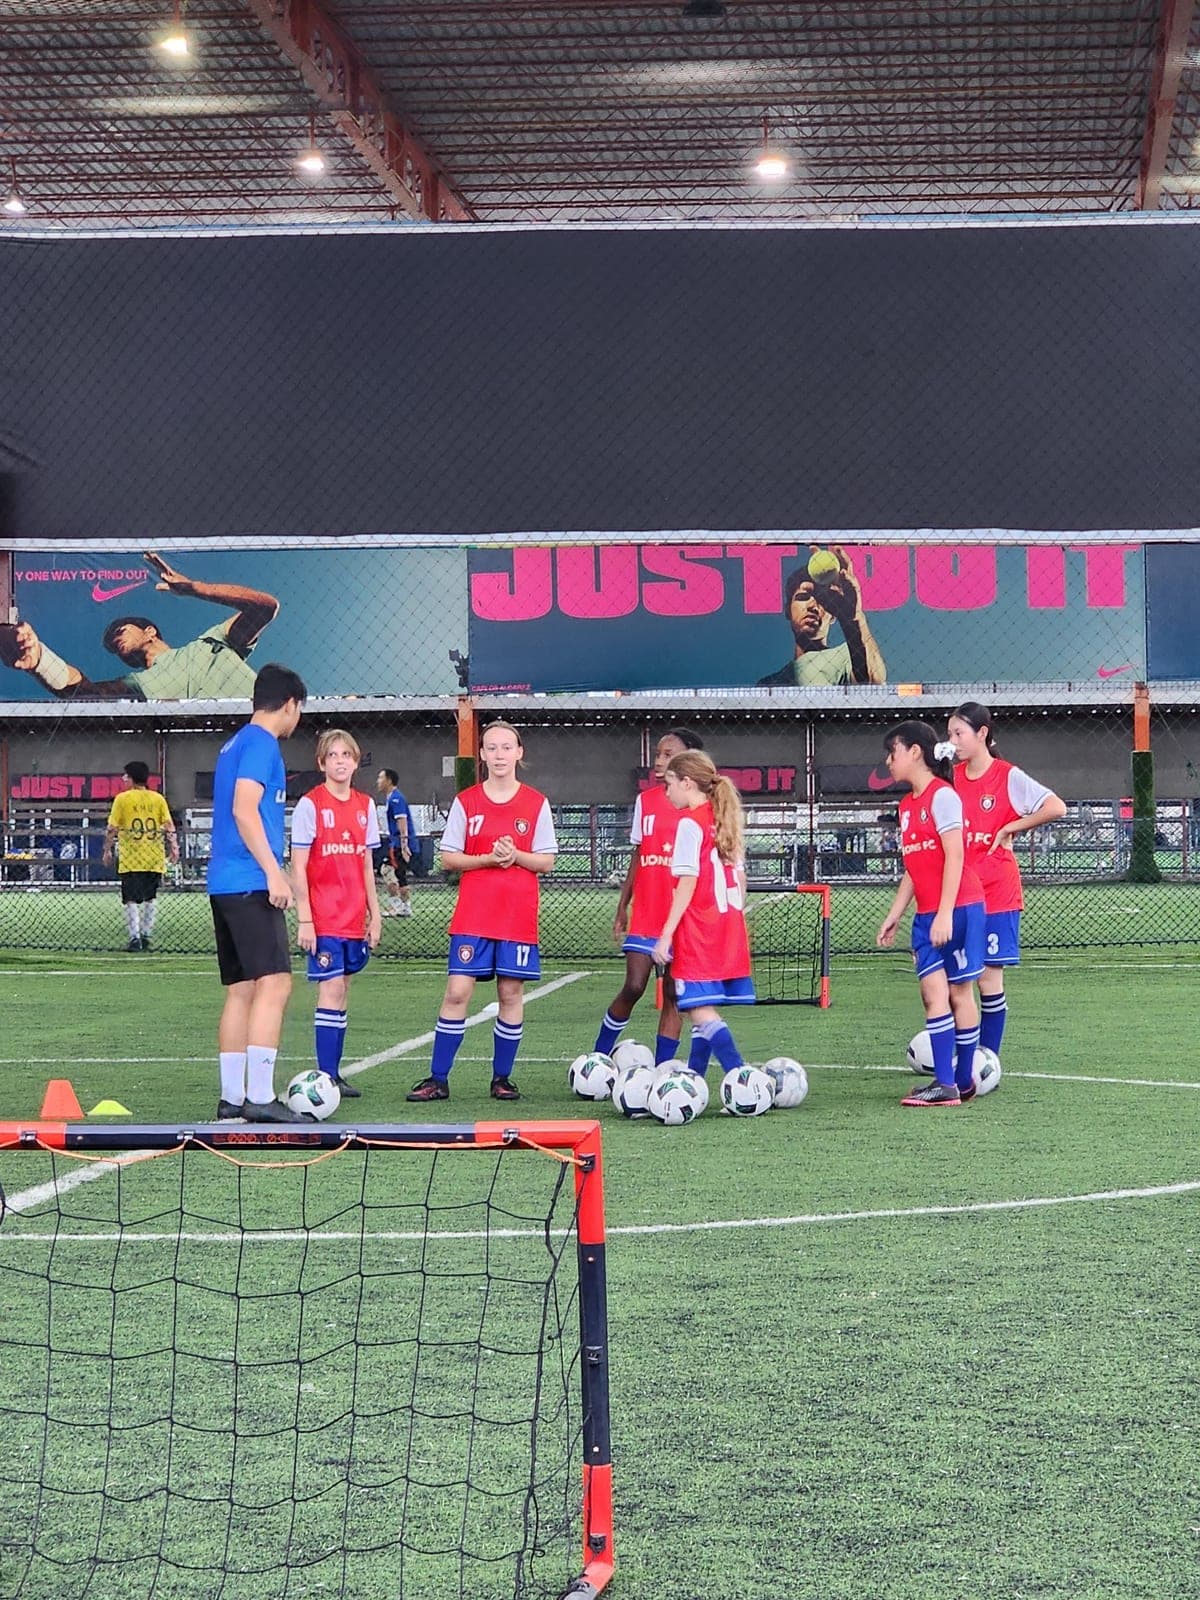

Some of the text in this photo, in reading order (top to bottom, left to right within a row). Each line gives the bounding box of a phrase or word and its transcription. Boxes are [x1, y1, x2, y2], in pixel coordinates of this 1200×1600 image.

[25, 571, 49, 581] ONE
[51, 570, 78, 581] WAY
[80, 570, 96, 580] TO
[97, 570, 124, 580] FIND
[125, 570, 149, 580] OUT
[471, 544, 1143, 622] JUST DO IT
[11, 776, 86, 799] JUST
[767, 768, 796, 791] IT
[131, 817, 157, 840] 99
[321, 808, 335, 828] 10
[468, 814, 485, 837] 17
[642, 815, 656, 836] 11
[922, 839, 937, 850] FC
[974, 832, 992, 845] FC
[322, 843, 355, 857] LIONS
[641, 855, 673, 867] LION
[987, 933, 999, 955] 3
[516, 944, 531, 967] 17
